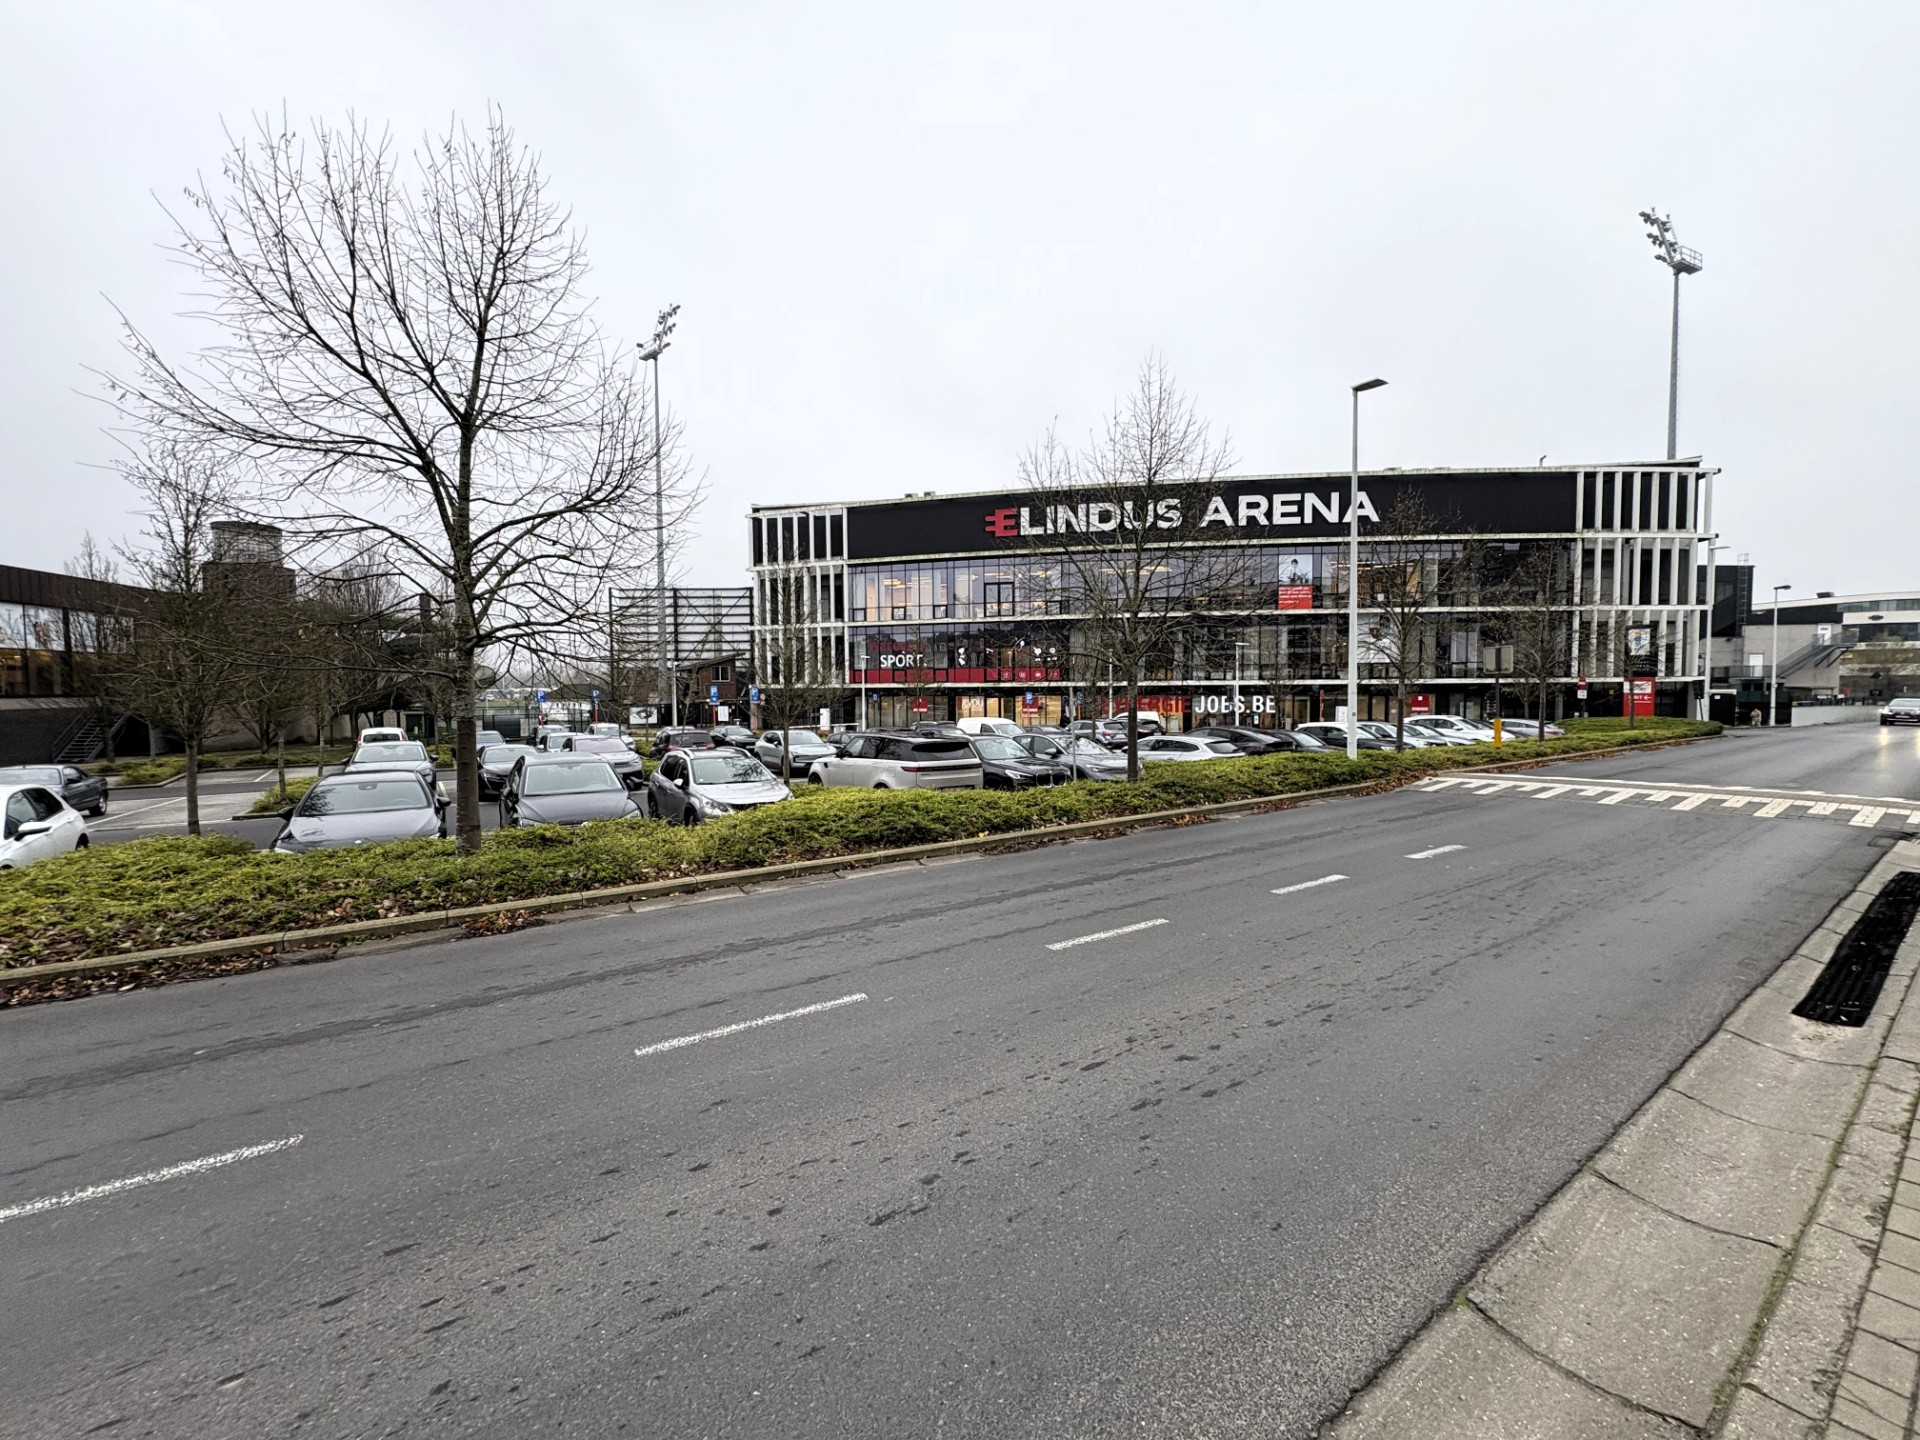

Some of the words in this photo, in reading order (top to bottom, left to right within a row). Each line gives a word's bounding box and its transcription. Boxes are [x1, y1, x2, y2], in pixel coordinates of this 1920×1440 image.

[985, 499, 1182, 537] ELINDUS
[1200, 491, 1380, 527] ARENA
[1195, 696, 1276, 713] JOBS.BE
